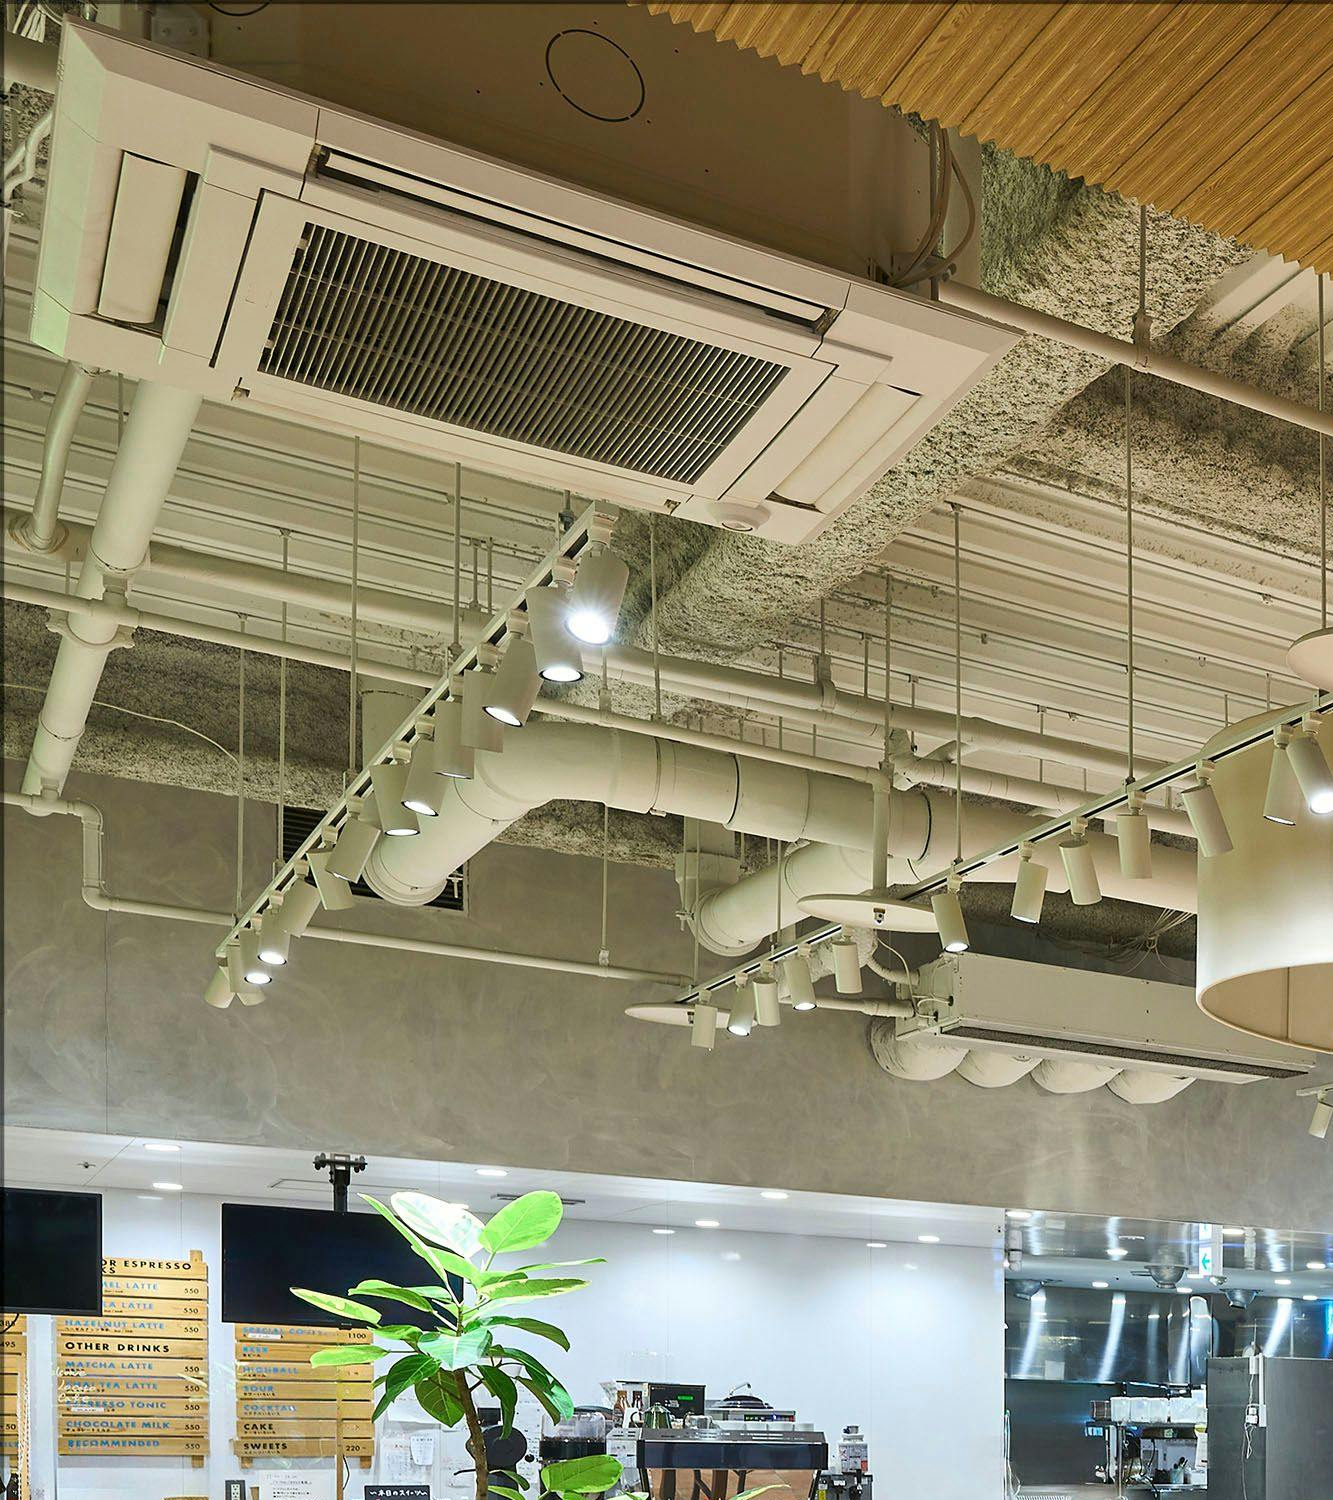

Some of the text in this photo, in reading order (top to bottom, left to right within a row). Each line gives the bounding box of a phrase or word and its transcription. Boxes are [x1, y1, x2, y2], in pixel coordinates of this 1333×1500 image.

[124, 1261, 191, 1270] ESPRESSO
[126, 1282, 158, 1290] LATTE
[122, 1302, 154, 1310] LATTE
[132, 1321, 165, 1330] LATTE
[65, 1341, 170, 1353] OTHER DRINKS
[65, 1360, 116, 1369] MATCHA
[121, 1361, 153, 1370] LATTE
[125, 1382, 158, 1390] LATTE
[130, 1401, 167, 1409] TONIC
[66, 1420, 136, 1429] CHOCOLATE
[141, 1421, 170, 1429] MILK
[243, 1423, 274, 1431] CAKE
[243, 1442, 288, 1450] SWEETS
